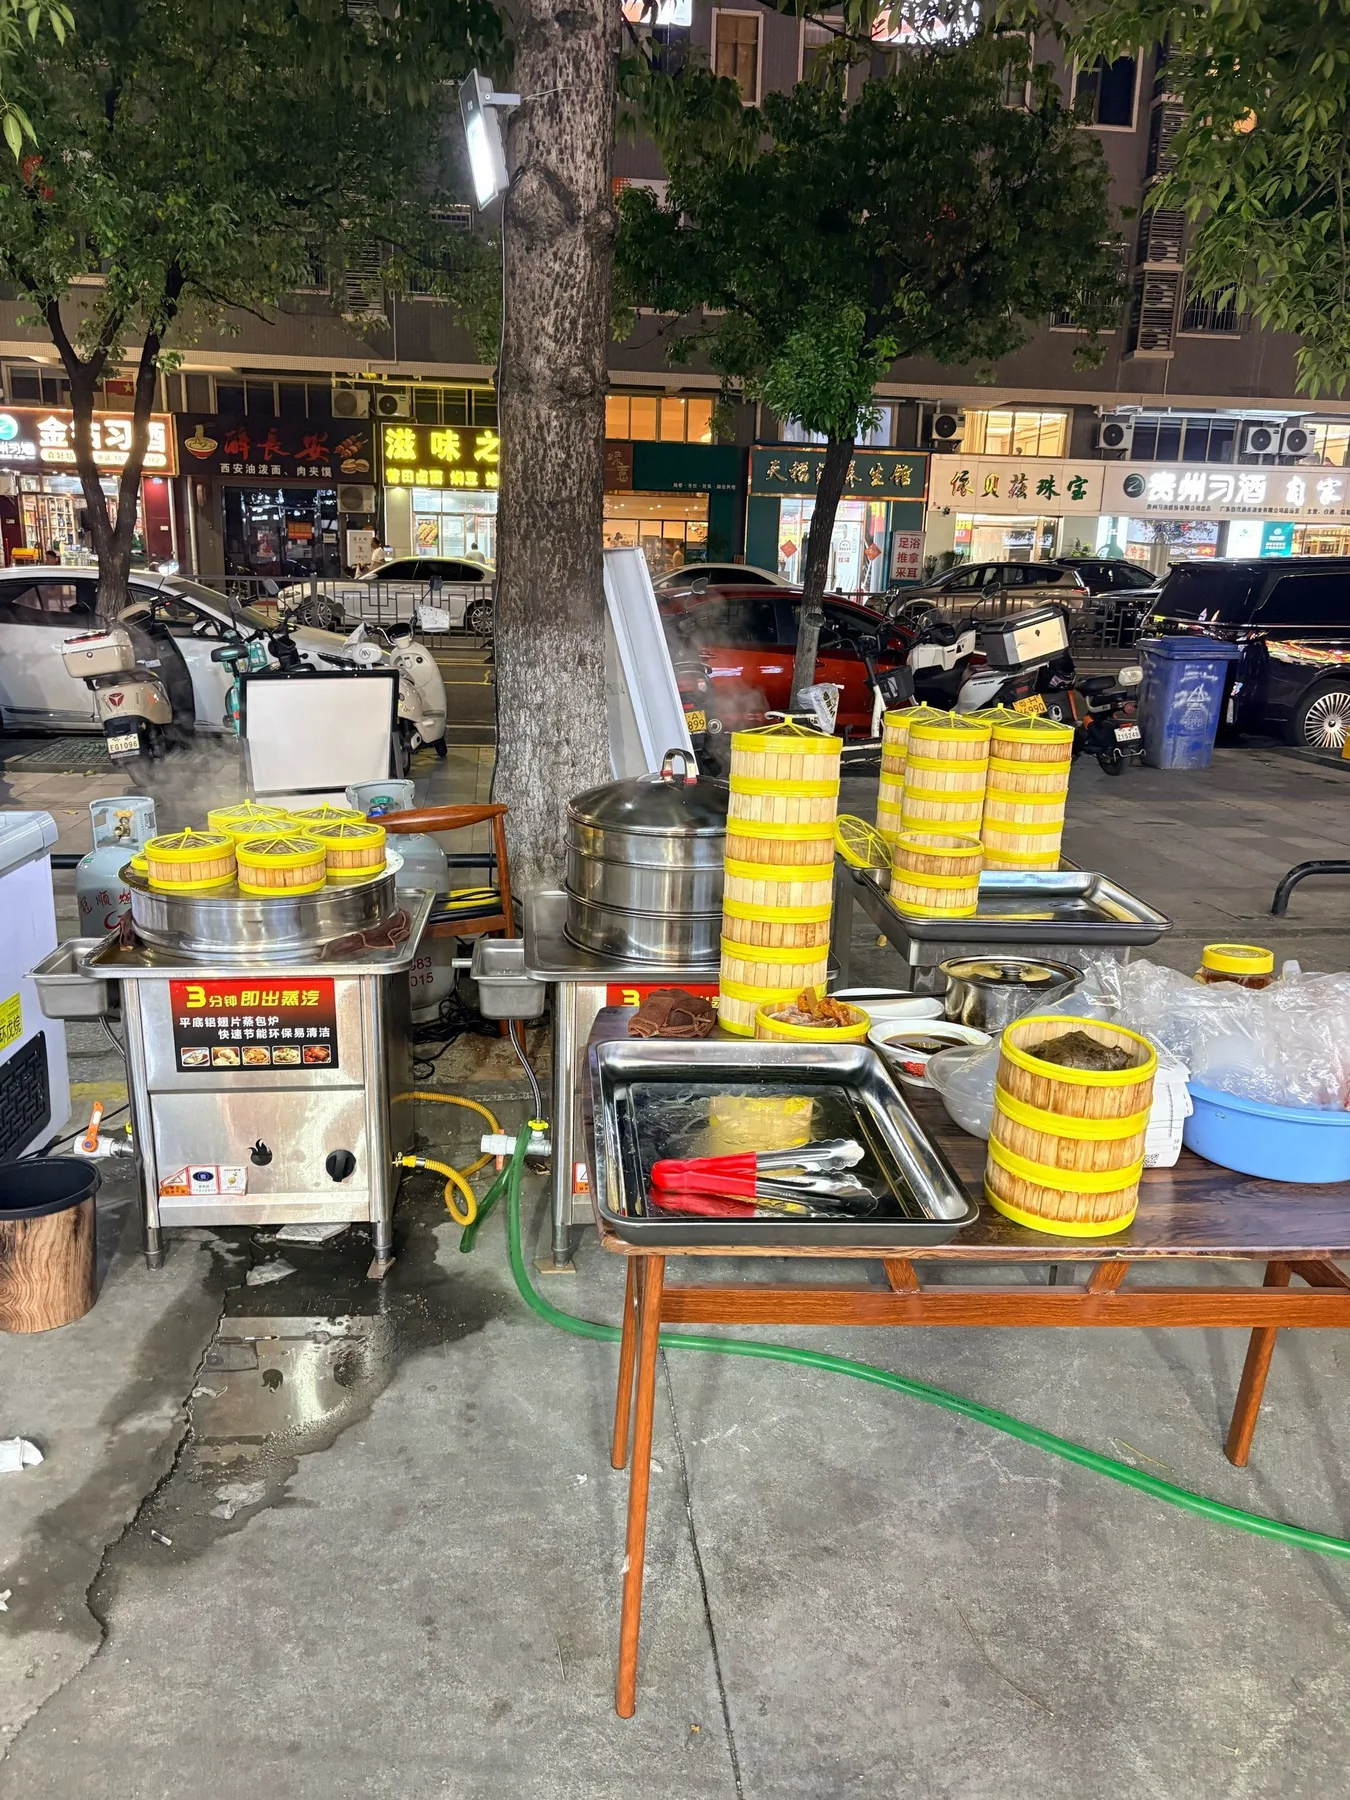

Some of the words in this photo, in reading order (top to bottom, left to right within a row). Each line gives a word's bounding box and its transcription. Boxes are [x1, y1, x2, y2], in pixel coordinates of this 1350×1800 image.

[385, 428, 499, 461] 滋味之
[220, 463, 333, 478] 西安油泼面、肉夹馍
[1147, 471, 1268, 503] 贵州习酒
[898, 538, 920, 549] 足浴
[897, 552, 920, 564] 推拿
[896, 567, 918, 578] 采耳
[110, 741, 138, 751] EG1096
[180, 1016, 279, 1028] 平底铝翅片蒸包炉
[218, 1027, 330, 1040] 快速节能环保易清洁
